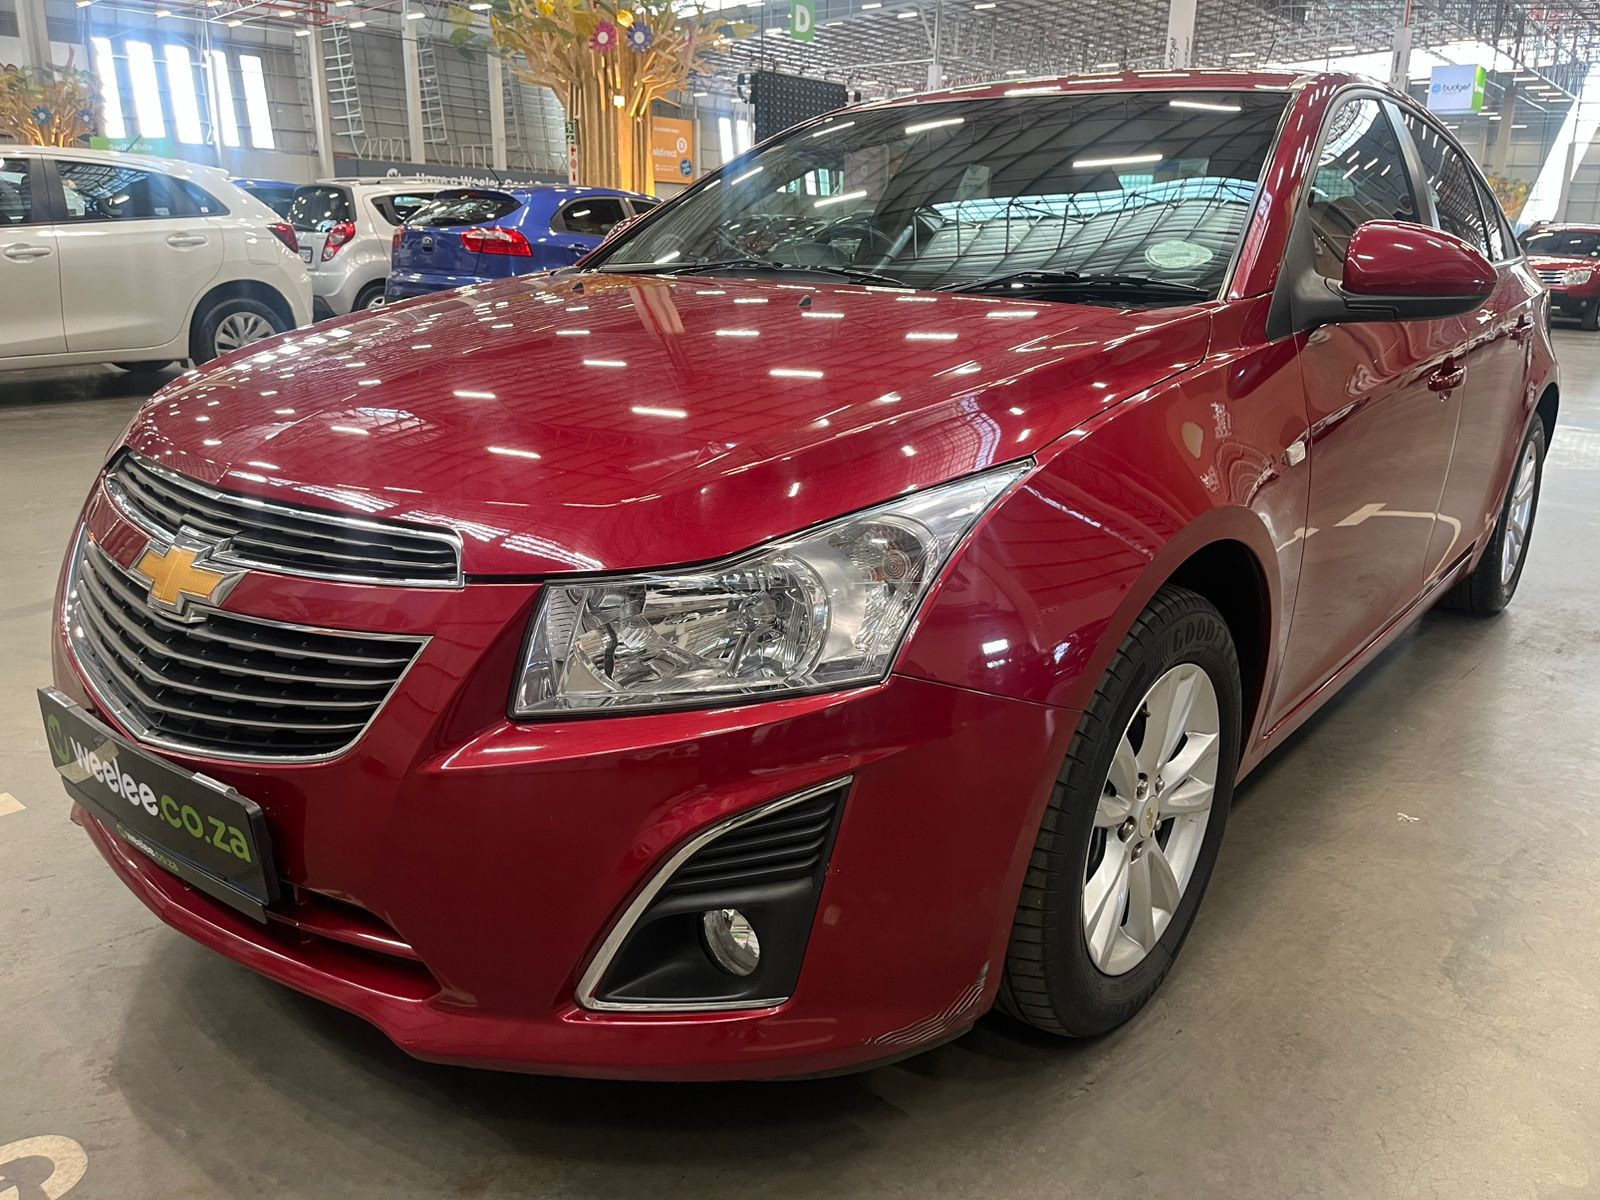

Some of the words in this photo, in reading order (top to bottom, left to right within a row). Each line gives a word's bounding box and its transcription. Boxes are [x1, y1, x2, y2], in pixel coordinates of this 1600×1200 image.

[795, 4, 810, 33] D
[1443, 83, 1470, 93] budget
[70, 736, 252, 864] weelee.co.za
